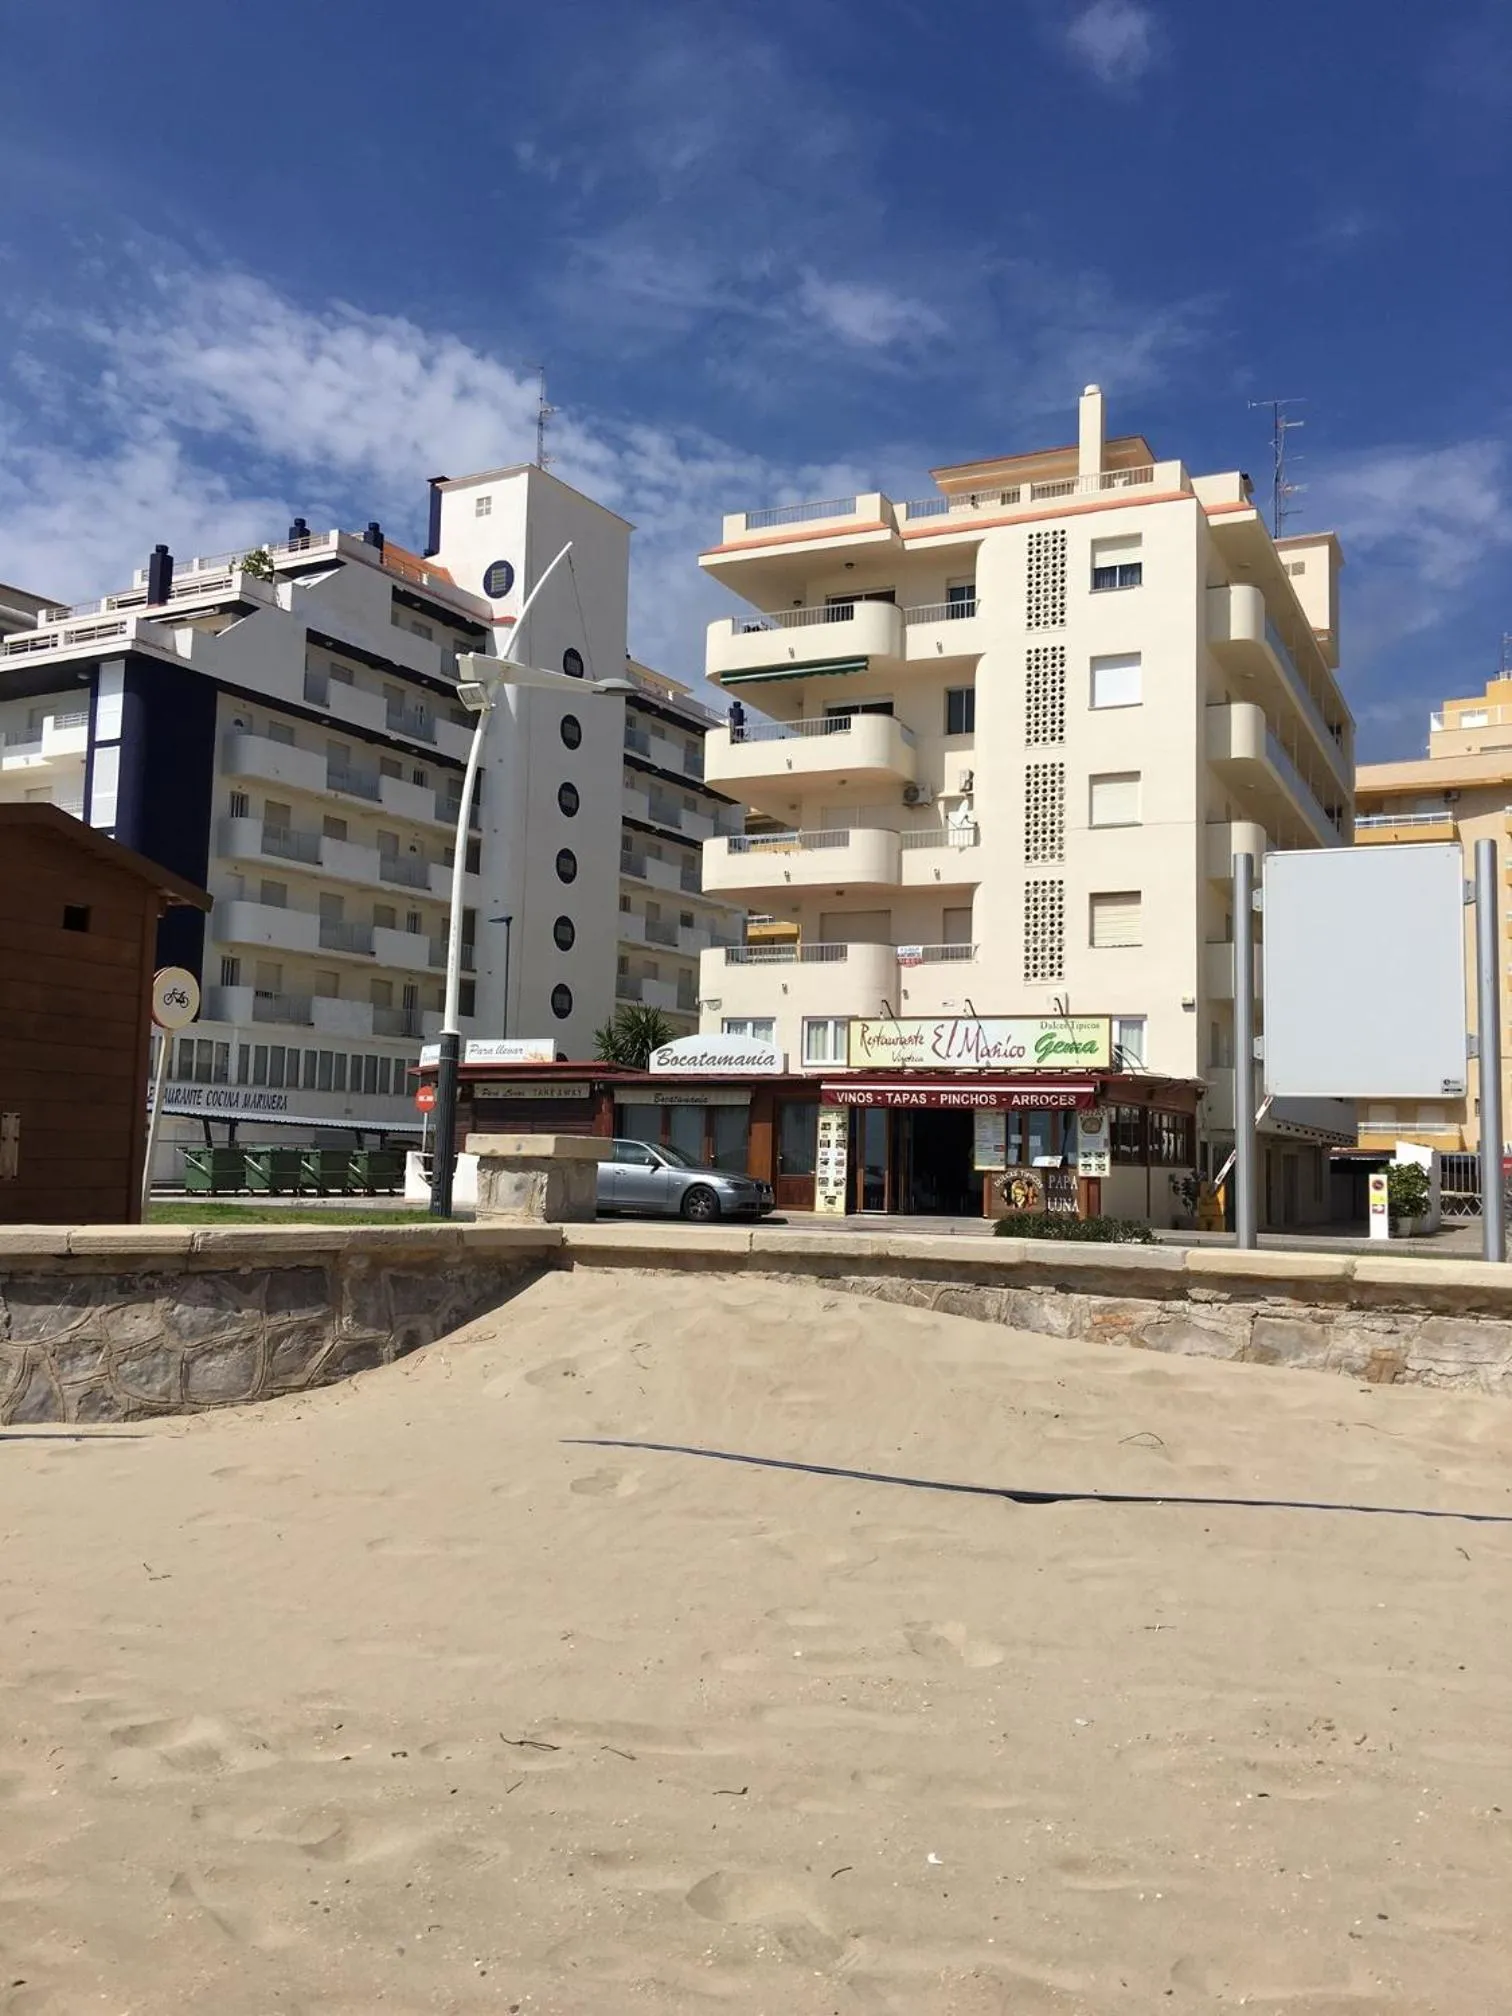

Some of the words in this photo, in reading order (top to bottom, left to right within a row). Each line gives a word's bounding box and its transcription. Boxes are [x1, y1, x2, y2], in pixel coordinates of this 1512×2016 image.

[860, 1023, 924, 1057] Restaurante
[931, 1020, 959, 1060] El
[1034, 1031, 1100, 1063] Gema
[206, 1089, 240, 1108] COCINA
[241, 1092, 288, 1111] MARINERA
[836, 1092, 873, 1103] VINOS
[885, 1093, 927, 1104] TAPAS
[940, 1093, 997, 1105] PINCHOS
[1011, 1094, 1076, 1106] ARROCES
[1048, 1175, 1079, 1190] PAPA
[1047, 1196, 1080, 1212] LUNA
